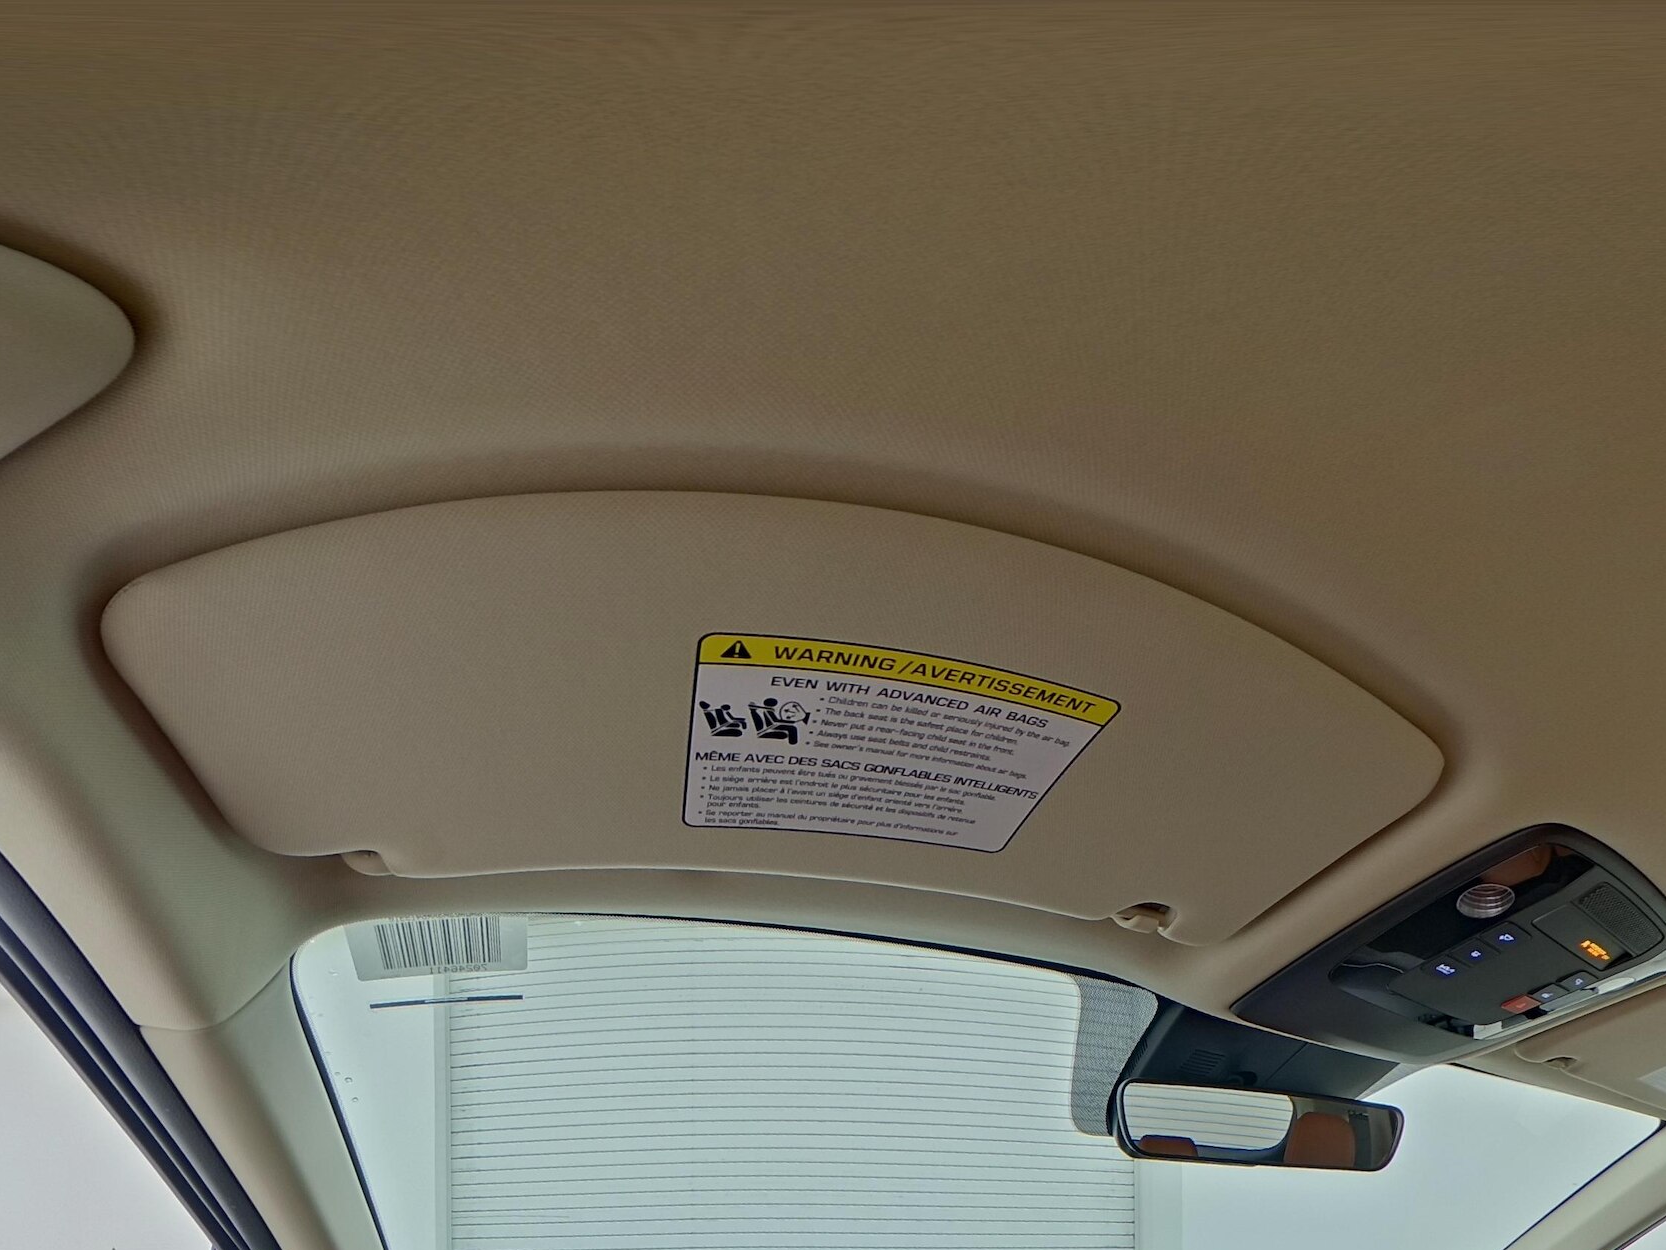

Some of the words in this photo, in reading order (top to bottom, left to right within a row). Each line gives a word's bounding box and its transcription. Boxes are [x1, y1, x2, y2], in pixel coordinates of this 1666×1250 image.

[775, 646, 896, 671] WARNING
[771, 676, 819, 690] EVEN
[826, 681, 870, 695] WITH
[876, 688, 969, 711] ADVANCED
[973, 705, 1002, 718] AIR
[1005, 711, 1049, 729] BAGS
[820, 719, 848, 729] Never
[850, 722, 866, 732] put
[875, 725, 926, 740] rear-facing
[926, 732, 947, 743] child
[948, 737, 967, 746] seat
[968, 739, 977, 747] in
[978, 742, 992, 751] the
[825, 707, 841, 716] The
[844, 709, 865, 719] back
[868, 713, 888, 722] seat
[890, 715, 898, 723] is
[899, 717, 915, 726] the
[916, 720, 944, 730] safest
[945, 725, 969, 736] place
[971, 729, 984, 738] for
[828, 696, 868, 708] Children
[871, 702, 887, 711] can
[890, 703, 902, 713] be
[904, 706, 928, 717] killed
[943, 714, 983, 727] seriously
[984, 720, 1014, 733] injured
[1014, 728, 1026, 737] by
[1026, 730, 1041, 739] the
[1042, 734, 1053, 743] air
[1055, 737, 1070, 748] bag
[813, 740, 830, 749] See
[830, 742, 864, 752] owner's
[865, 746, 895, 756] manual
[895, 750, 909, 758] for
[909, 752, 931, 761] more
[931, 754, 975, 768] information
[975, 763, 997, 773] about
[816, 729, 848, 740] Always
[850, 733, 866, 741] use
[867, 735, 887, 744] seat
[888, 738, 910, 747] belts
[911, 741, 928, 750] and
[928, 744, 949, 754] child
[695, 750, 741, 762] MÊME
[744, 753, 785, 764] AVEC
[788, 756, 818, 767] DES
[820, 759, 861, 771] SACS
[863, 763, 953, 783] GONFLABLES
[953, 776, 1039, 800] INTELLIGENTS
[728, 765, 761, 773] enfants
[762, 768, 795, 777] peuvent
[722, 785, 749, 793] jamais
[751, 786, 778, 795] placer
[839, 783, 857, 791] plus
[903, 791, 923, 799] pour
